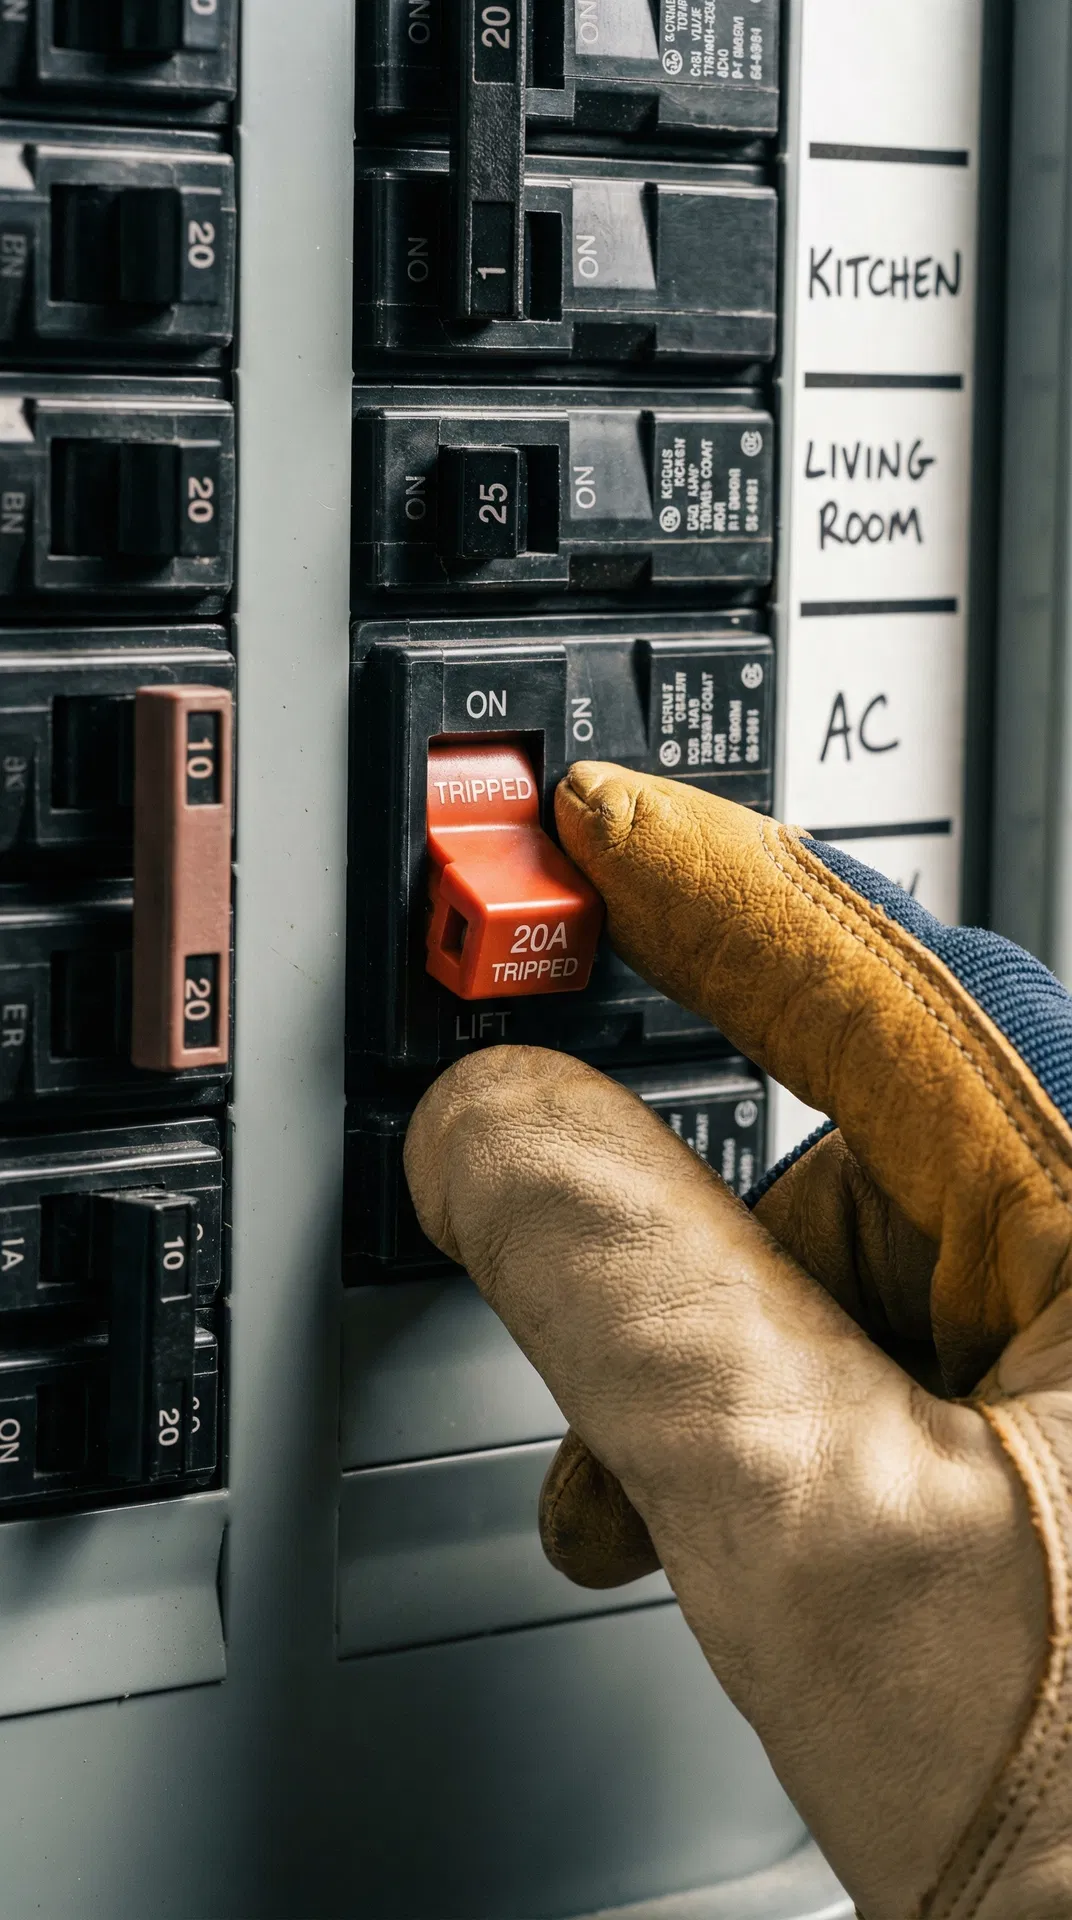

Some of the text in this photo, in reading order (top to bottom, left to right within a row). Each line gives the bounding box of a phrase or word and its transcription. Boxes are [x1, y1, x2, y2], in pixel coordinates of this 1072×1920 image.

[408, 0, 431, 44] ON
[481, 5, 511, 49] 20
[579, 0, 599, 45] ON
[187, 220, 215, 270] 20
[407, 237, 429, 283] ON
[575, 234, 599, 279] ON
[476, 266, 507, 280] 1
[808, 246, 962, 301] KITCHEN
[804, 438, 937, 481] LIVING
[187, 476, 215, 524] 20
[405, 475, 427, 521] ON
[479, 482, 509, 525] 25
[573, 465, 596, 510] ON
[0, 490, 27, 534] BN
[819, 500, 923, 551] ROOM
[466, 689, 507, 719] ON
[571, 697, 594, 742] ON
[818, 690, 900, 763] AC
[186, 737, 214, 780] 10
[433, 776, 534, 805] TRIPPED
[510, 921, 569, 955] 20A
[492, 957, 579, 983] TRIPPED
[184, 977, 212, 1022] 20
[456, 1011, 512, 1042] LIFT
[163, 1234, 185, 1271] 10
[0, 1418, 21, 1464] ON
[157, 1407, 181, 1447] 20
